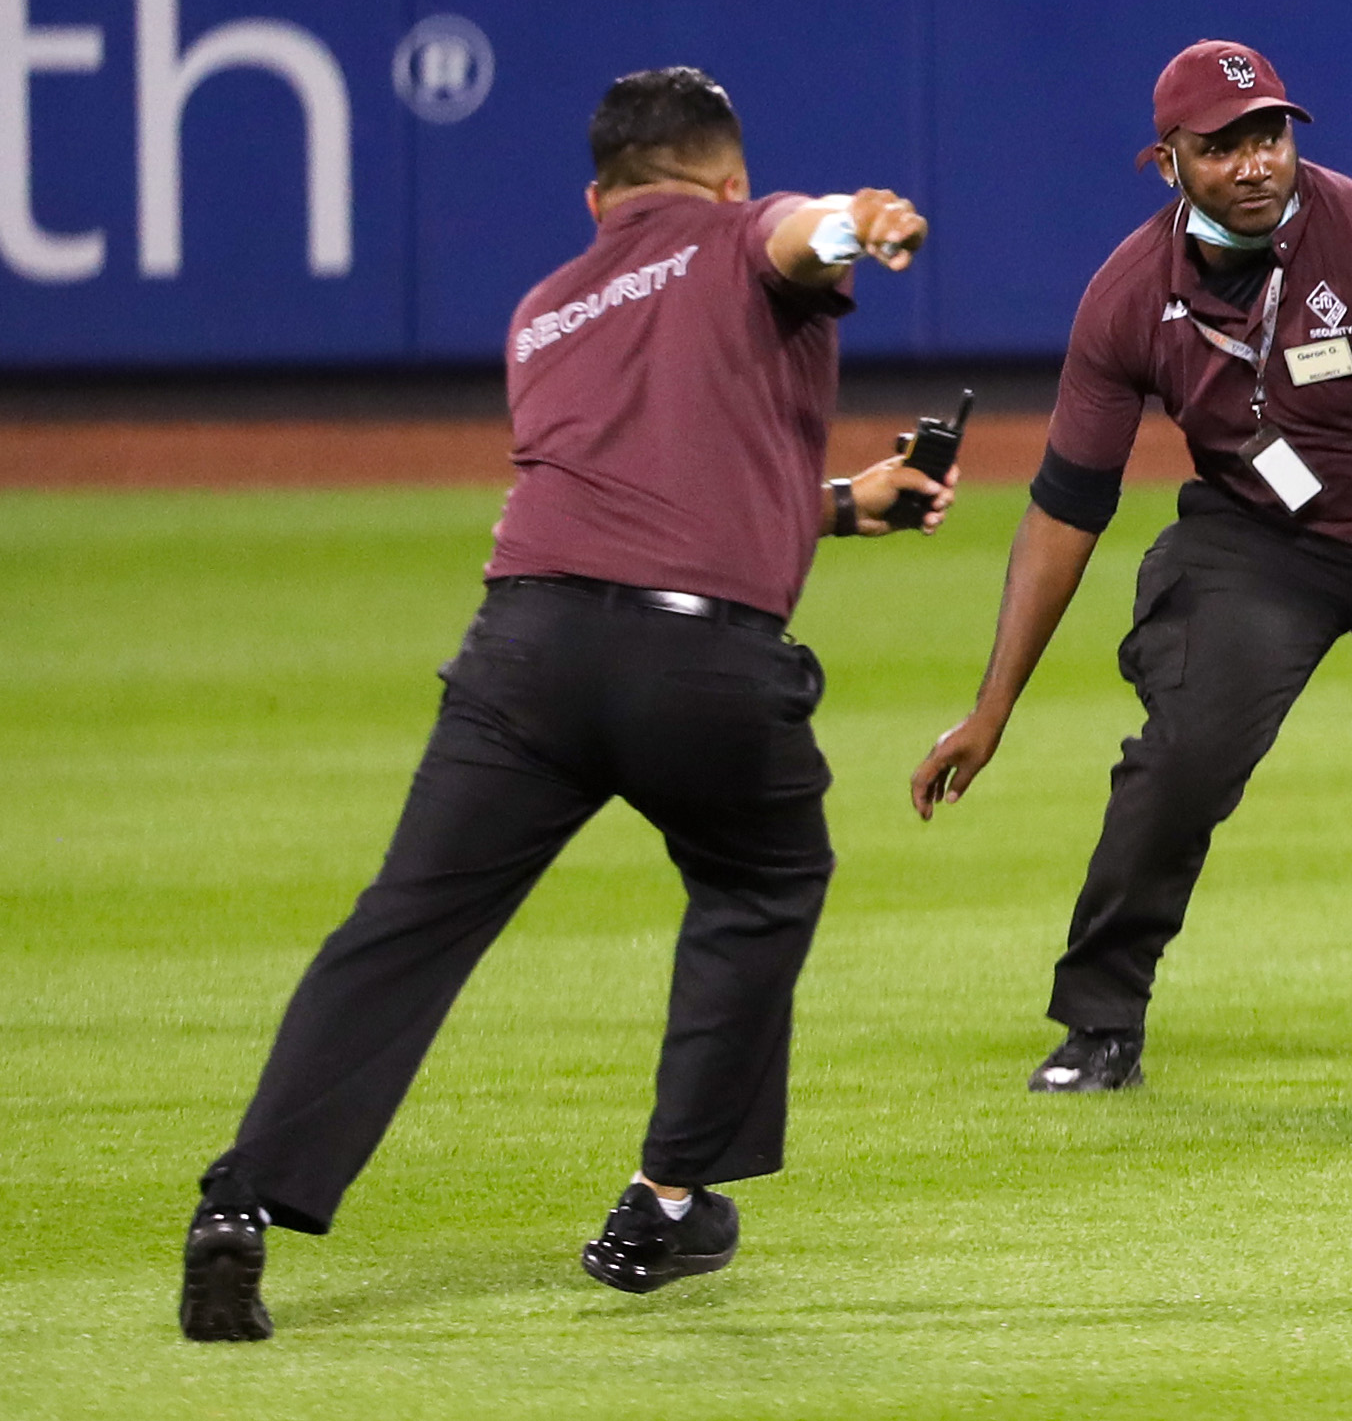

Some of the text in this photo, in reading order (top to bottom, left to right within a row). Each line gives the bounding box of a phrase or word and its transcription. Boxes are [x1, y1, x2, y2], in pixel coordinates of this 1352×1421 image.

[514, 244, 700, 364] SECURITY
[1311, 292, 1333, 310] citi
[1309, 325, 1352, 339] SECURITY
